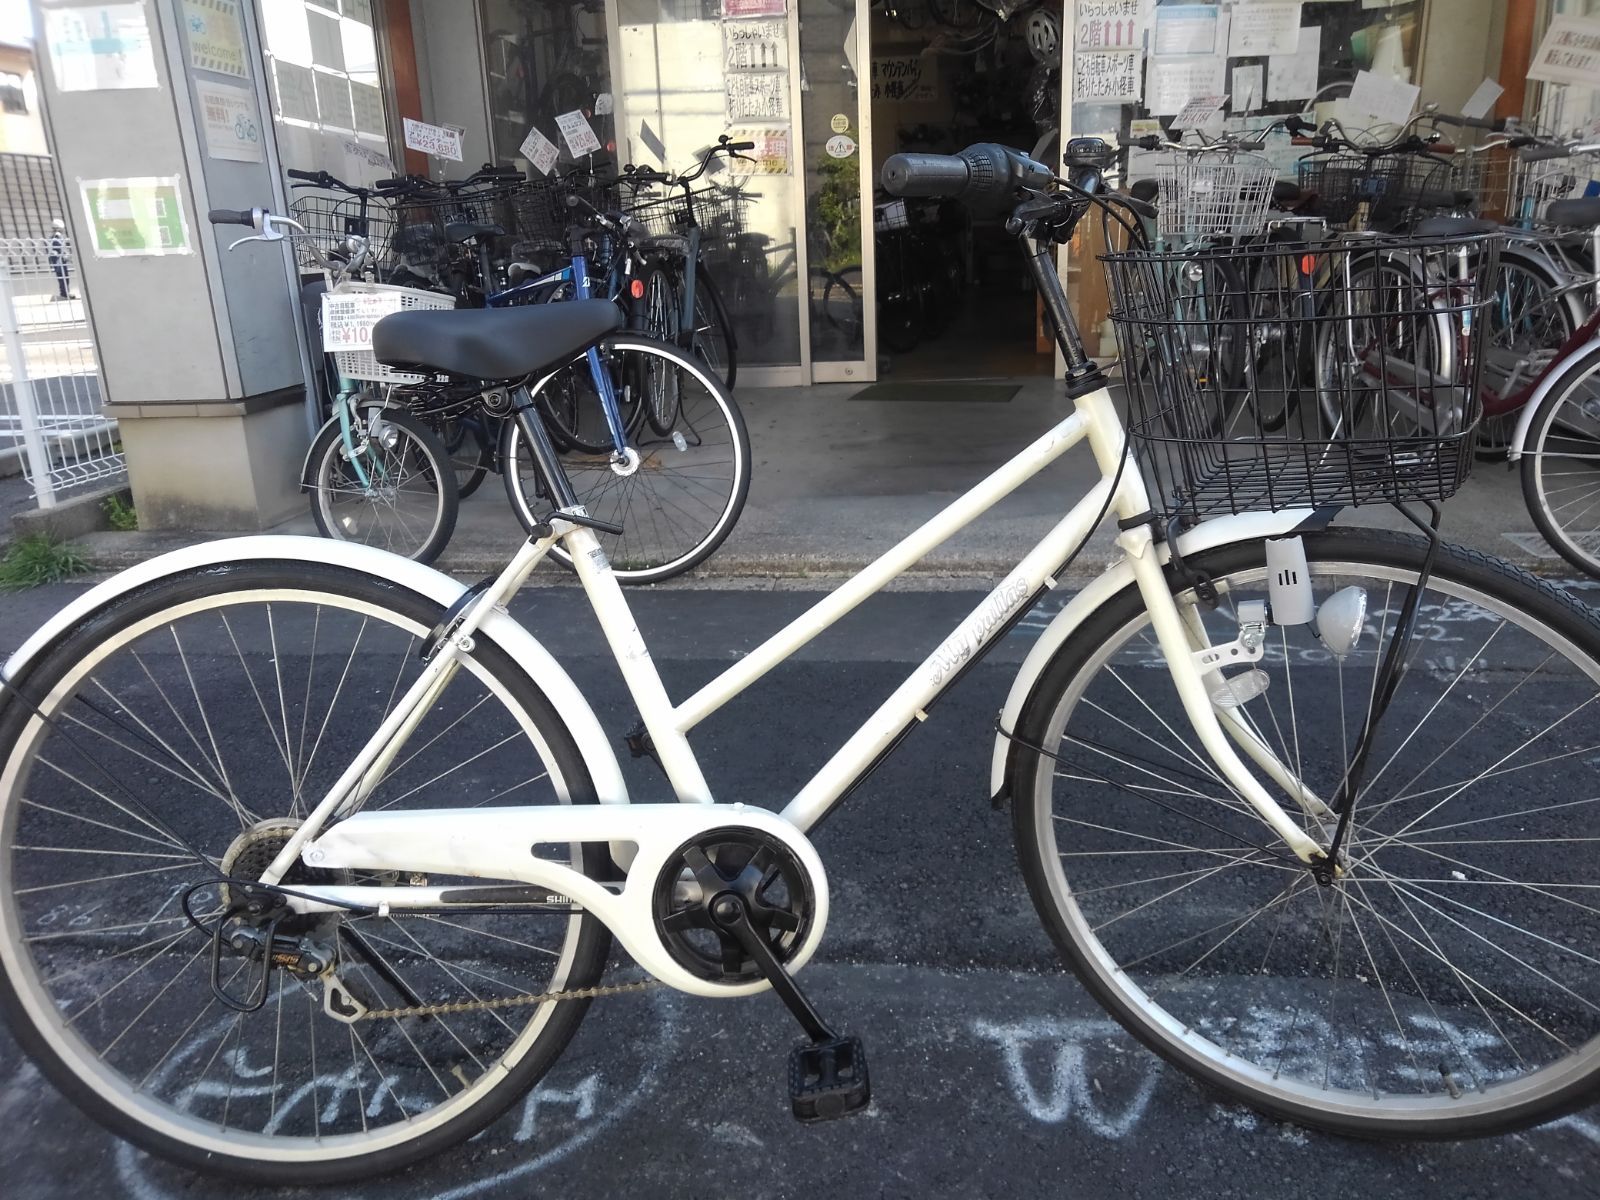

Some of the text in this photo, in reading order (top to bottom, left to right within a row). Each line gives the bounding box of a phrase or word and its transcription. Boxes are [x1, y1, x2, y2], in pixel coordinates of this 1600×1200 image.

[1080, 0, 1138, 17] いらっしゃいませ
[724, 23, 781, 40] いらっしゃいませ
[1080, 19, 1102, 47] 2階
[727, 42, 748, 69] 2階
